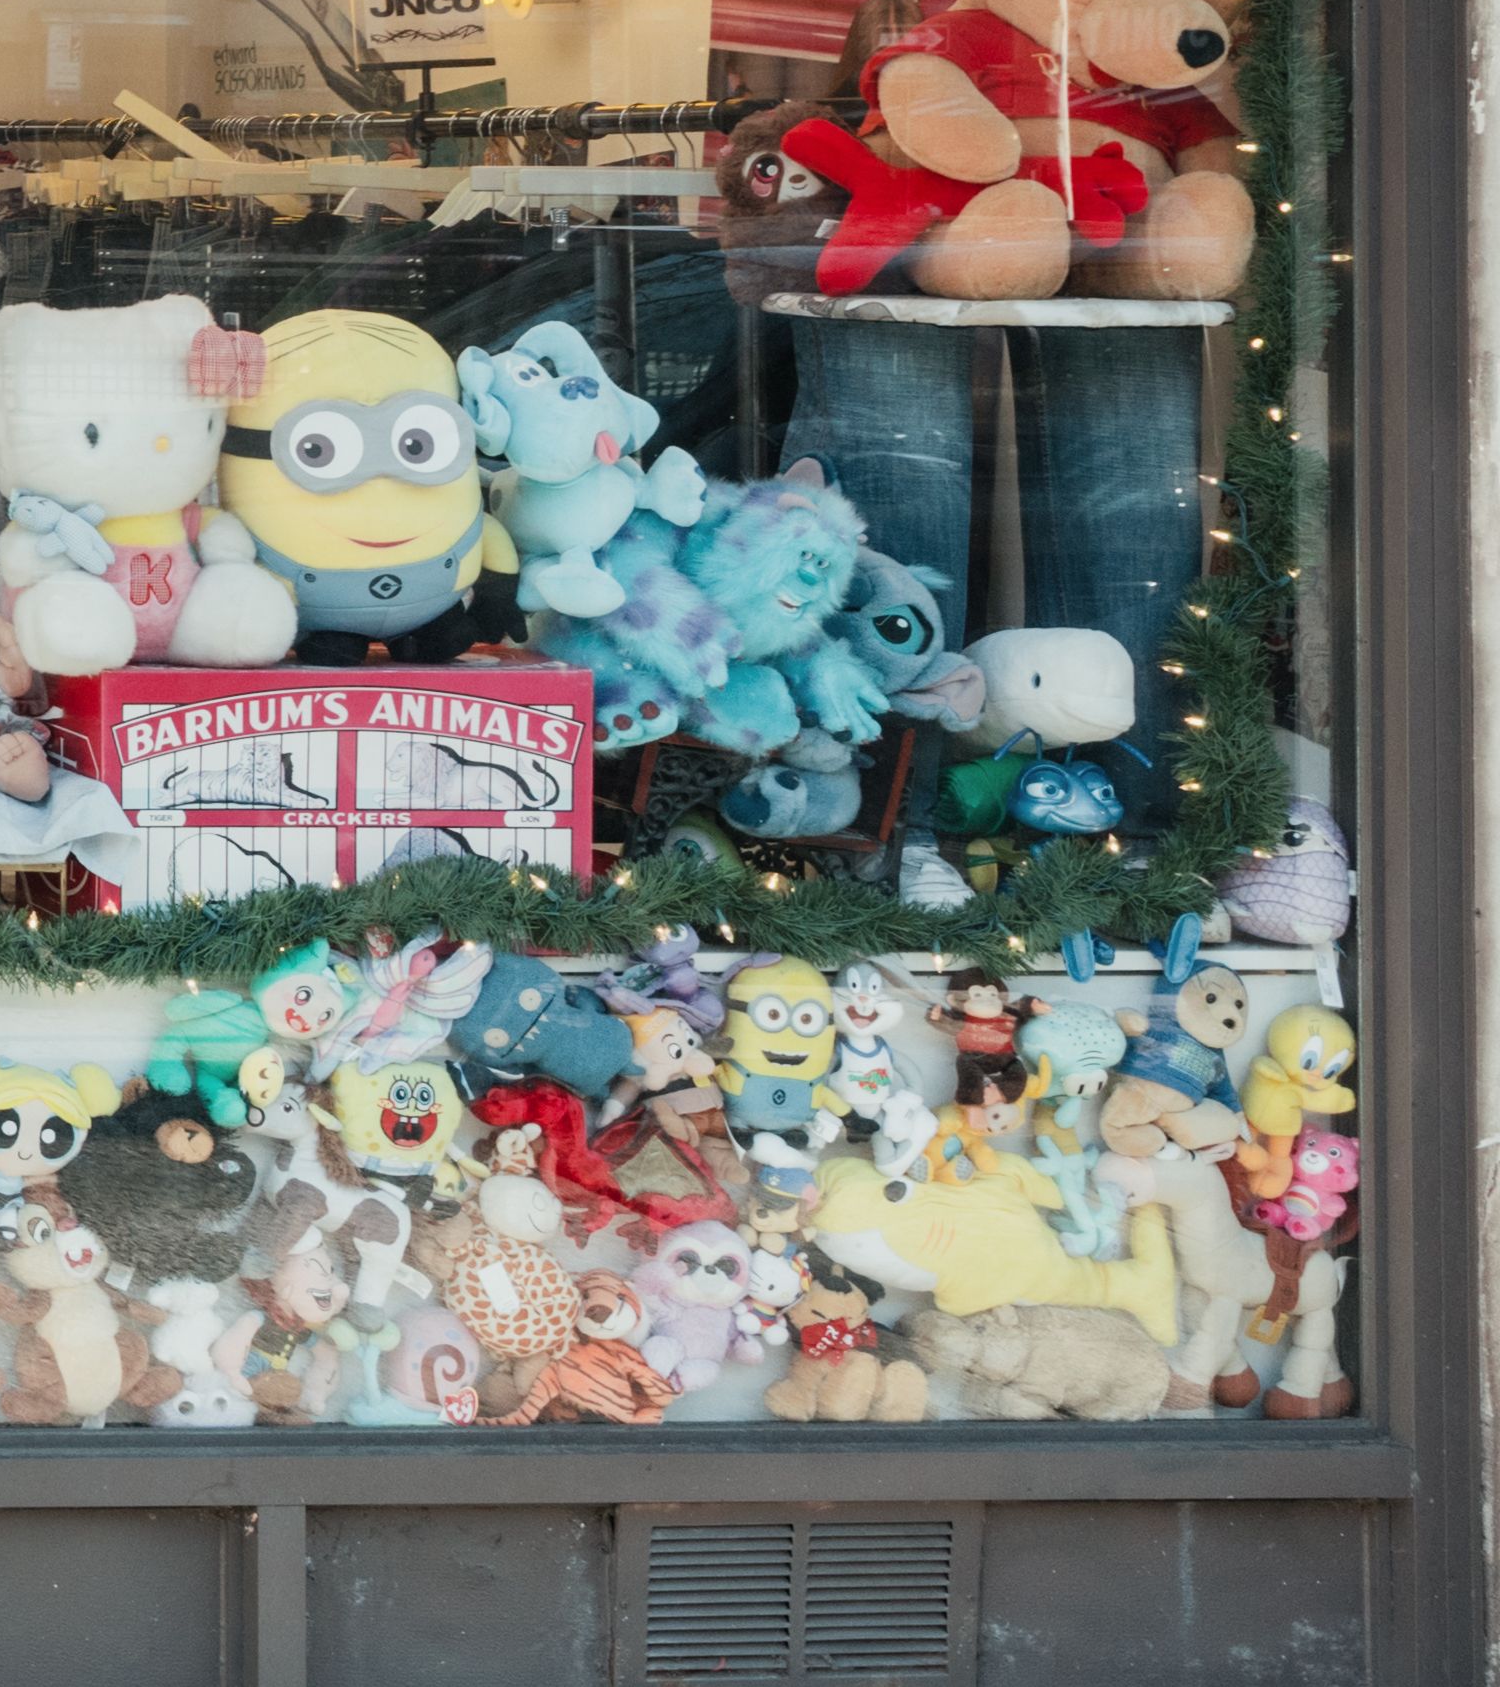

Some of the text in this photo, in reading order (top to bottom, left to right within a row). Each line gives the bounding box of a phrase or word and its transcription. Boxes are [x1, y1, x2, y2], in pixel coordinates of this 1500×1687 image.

[213, 40, 258, 67] edward
[214, 65, 306, 95] SCISSORHANDS
[127, 691, 570, 762] BARNUM'S ANIMALS
[282, 811, 412, 827] CRACKERS
